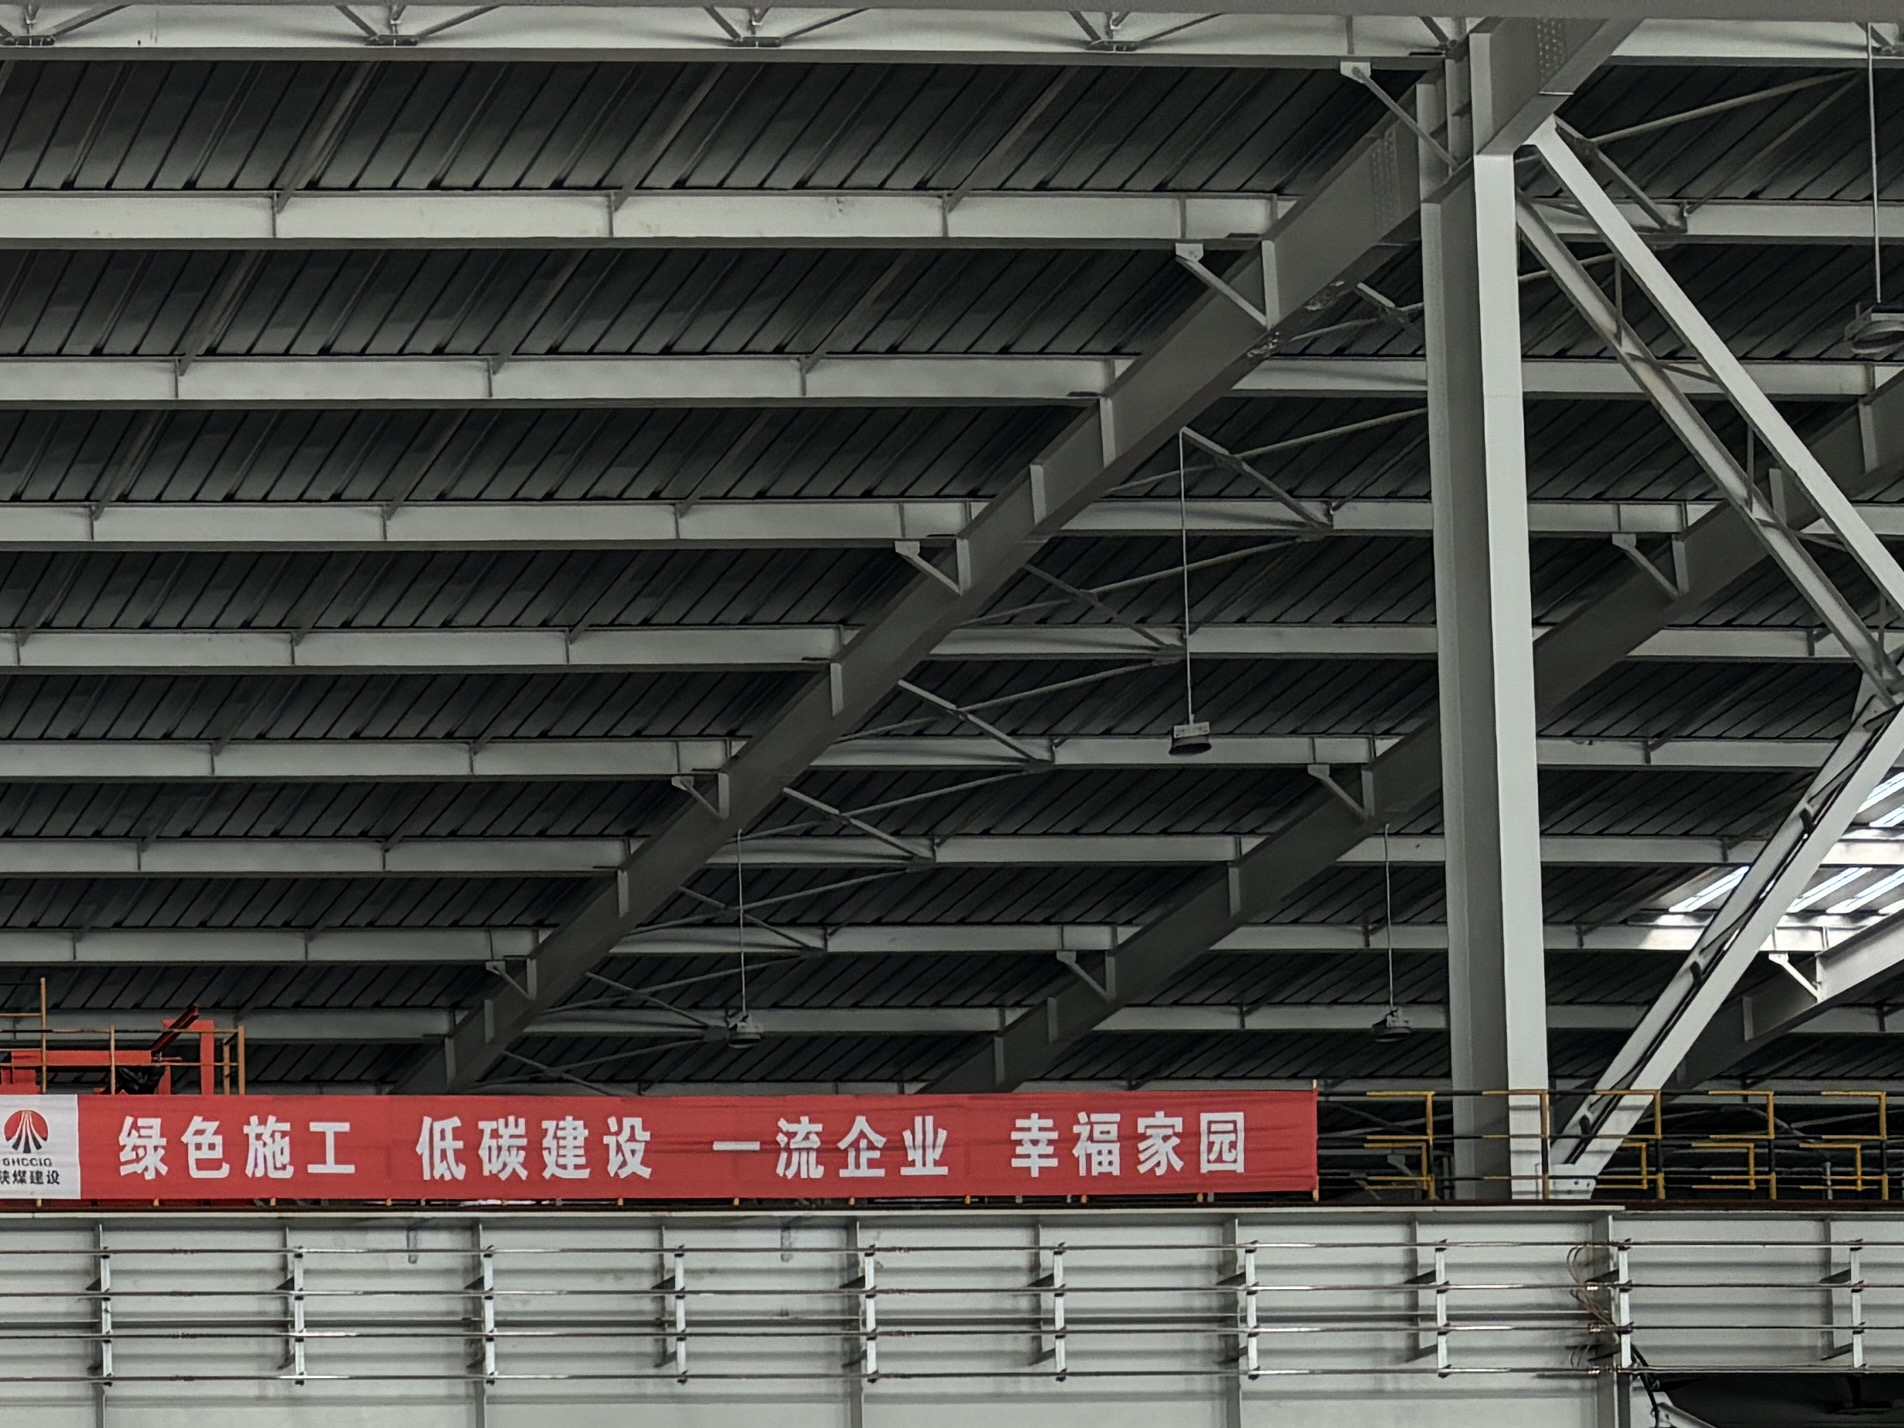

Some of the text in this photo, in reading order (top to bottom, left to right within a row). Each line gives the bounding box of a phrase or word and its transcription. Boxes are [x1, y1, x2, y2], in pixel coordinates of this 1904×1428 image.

[118, 1111, 1246, 1181] 绿色施工 低碳建设 一流企业 幸福家园
